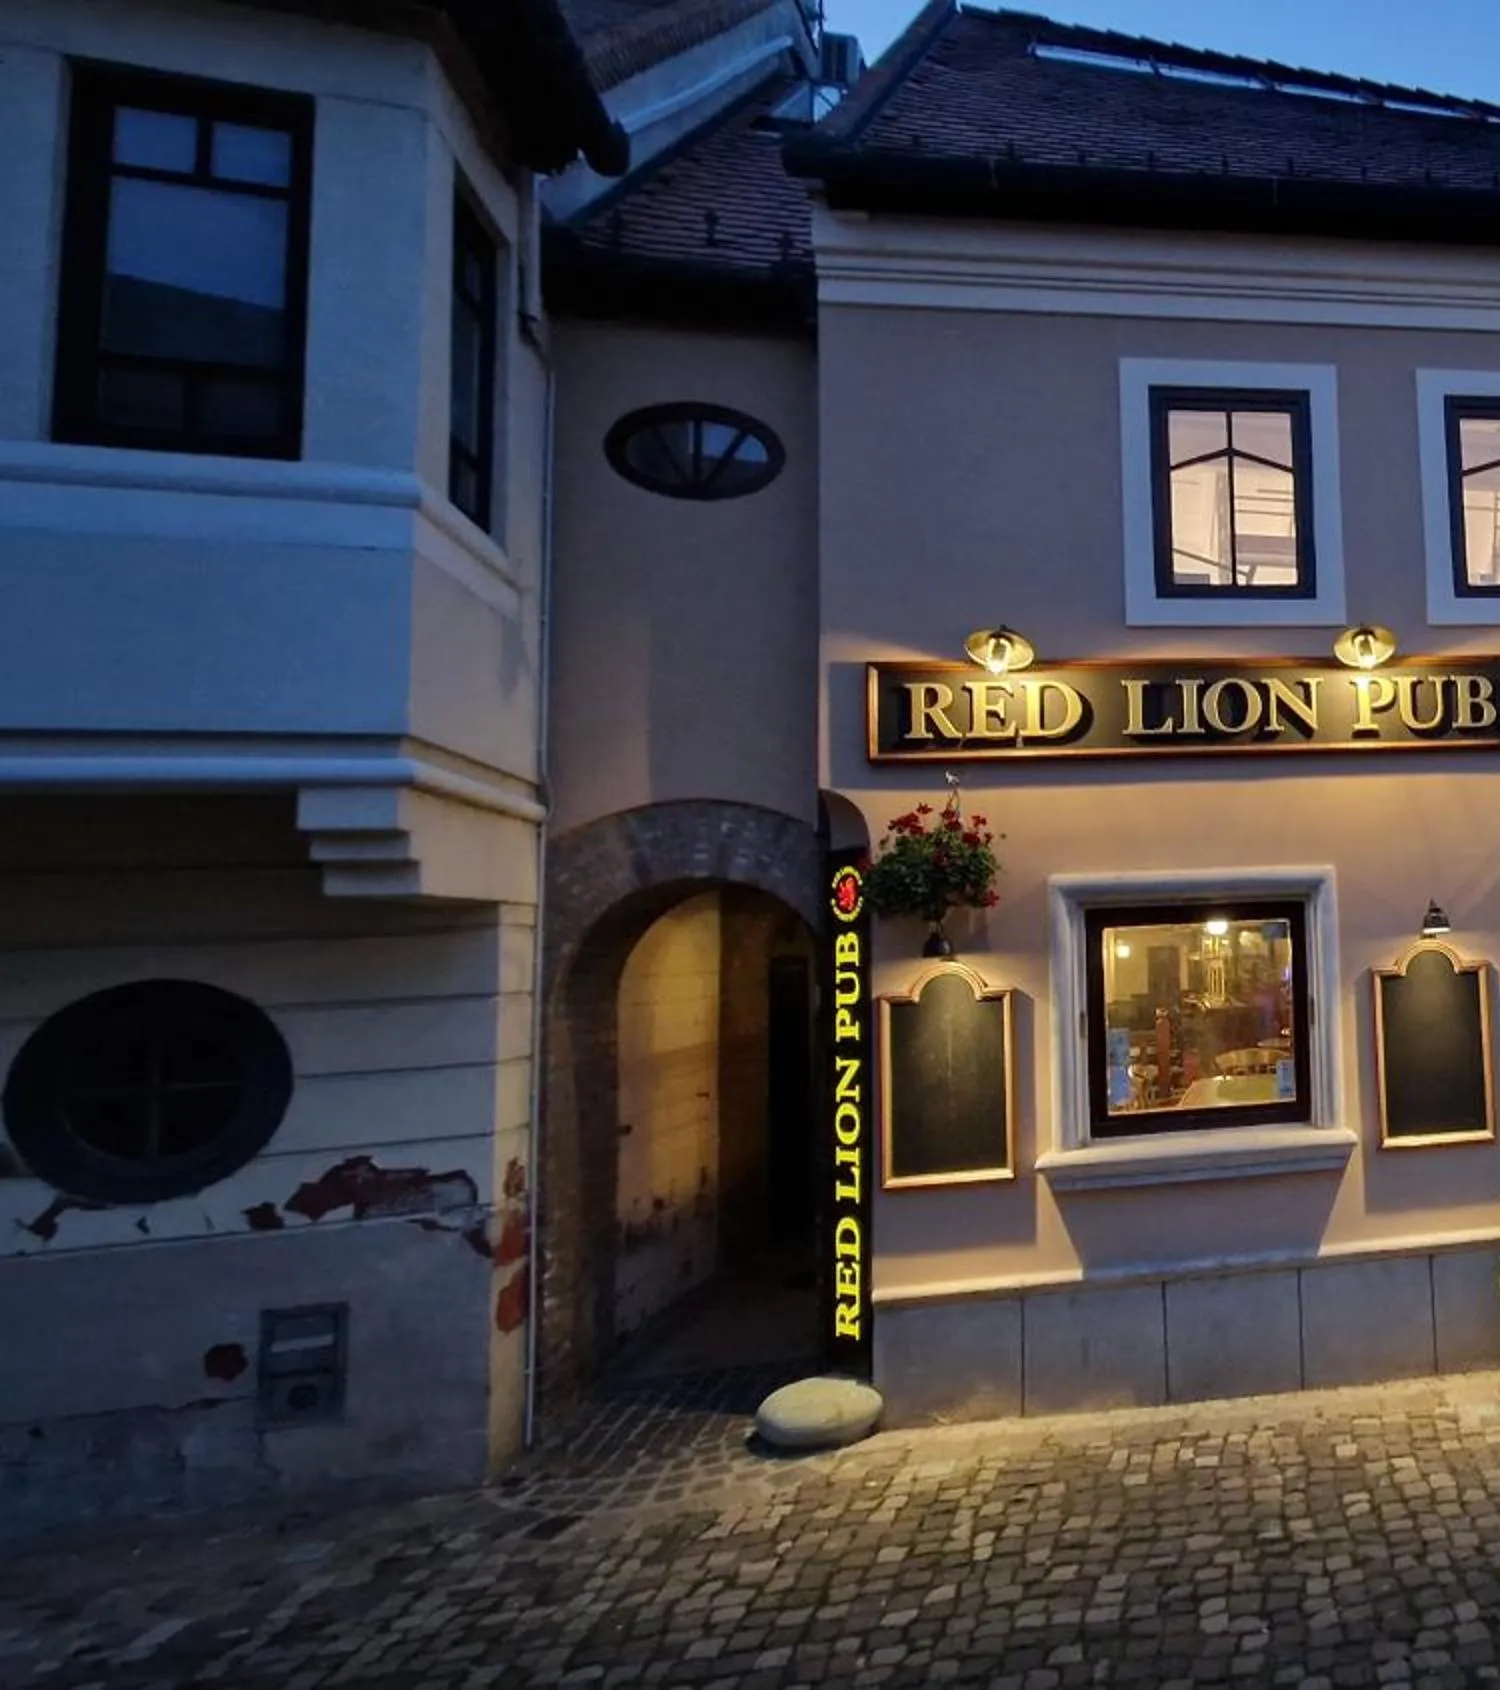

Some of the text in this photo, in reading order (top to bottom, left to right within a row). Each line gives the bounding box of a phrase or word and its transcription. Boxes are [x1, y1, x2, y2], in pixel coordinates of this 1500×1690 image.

[903, 679, 1083, 740] RED
[1121, 677, 1322, 736] LION
[1349, 674, 1498, 731] PUB
[835, 930, 861, 1042] PUB
[835, 1056, 861, 1205] LION
[835, 1216, 861, 1342] RED
